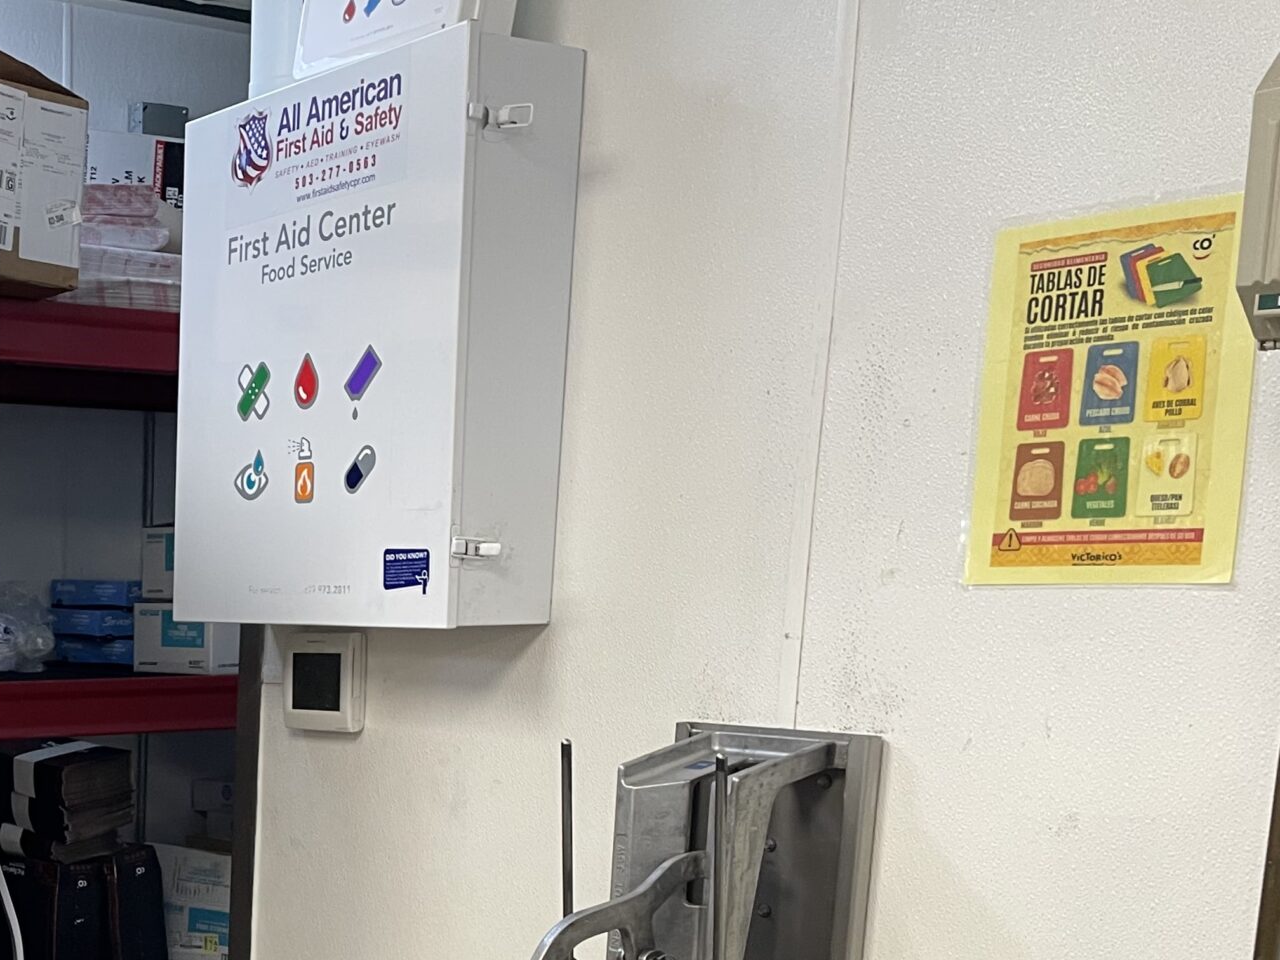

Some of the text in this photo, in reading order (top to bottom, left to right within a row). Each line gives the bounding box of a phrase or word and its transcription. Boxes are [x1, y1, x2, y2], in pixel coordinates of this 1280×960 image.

[277, 72, 402, 137] All American
[276, 103, 403, 162] First Aid & Safety
[274, 132, 401, 179] SAFETY AED TRAINING EYEWASH
[294, 154, 376, 190] 503-277-0563
[296, 173, 376, 202] www.firstaidsafetycpr.com
[227, 202, 396, 265] First Aid Center
[261, 248, 353, 284] Food Service
[1030, 264, 1107, 295] TABLAS DE
[1026, 289, 1105, 325] CORTAR
